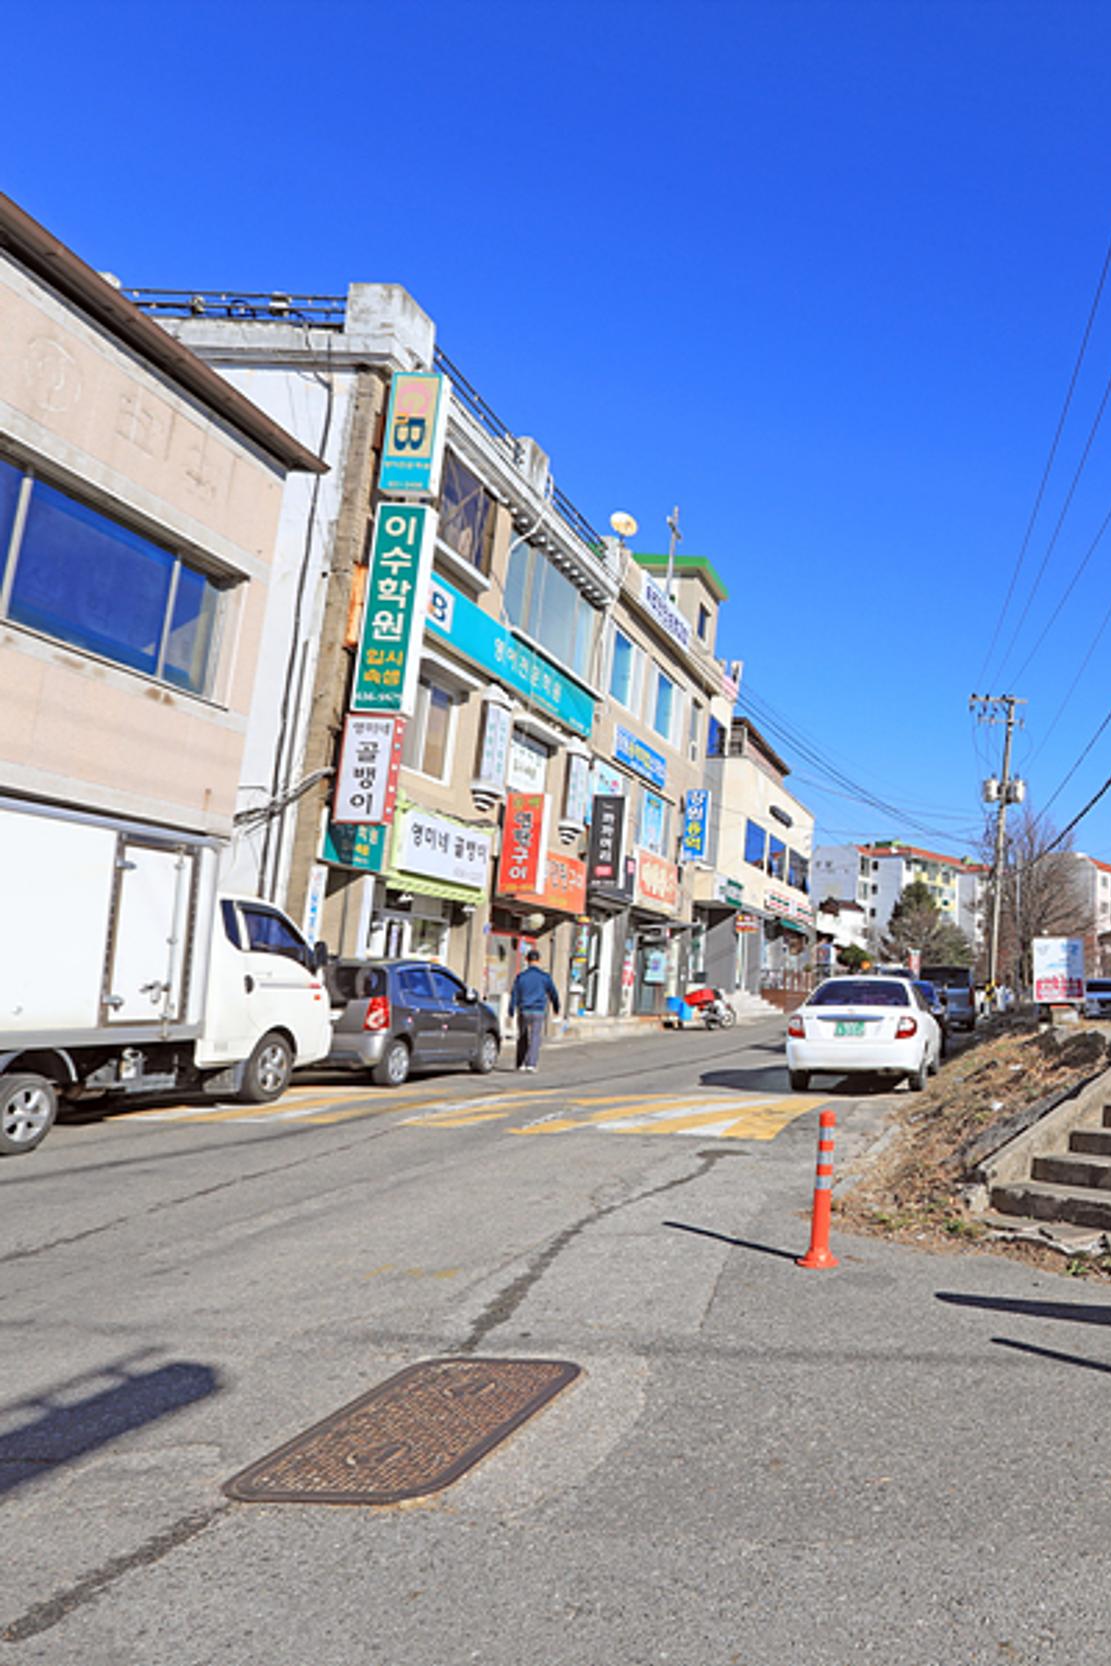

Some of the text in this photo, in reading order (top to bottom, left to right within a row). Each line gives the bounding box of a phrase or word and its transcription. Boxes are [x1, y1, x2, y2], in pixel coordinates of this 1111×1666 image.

[371, 514, 418, 642] 이수학원
[366, 647, 405, 667] 입시
[350, 741, 380, 815] 골뱅이
[411, 822, 450, 853] 영미네
